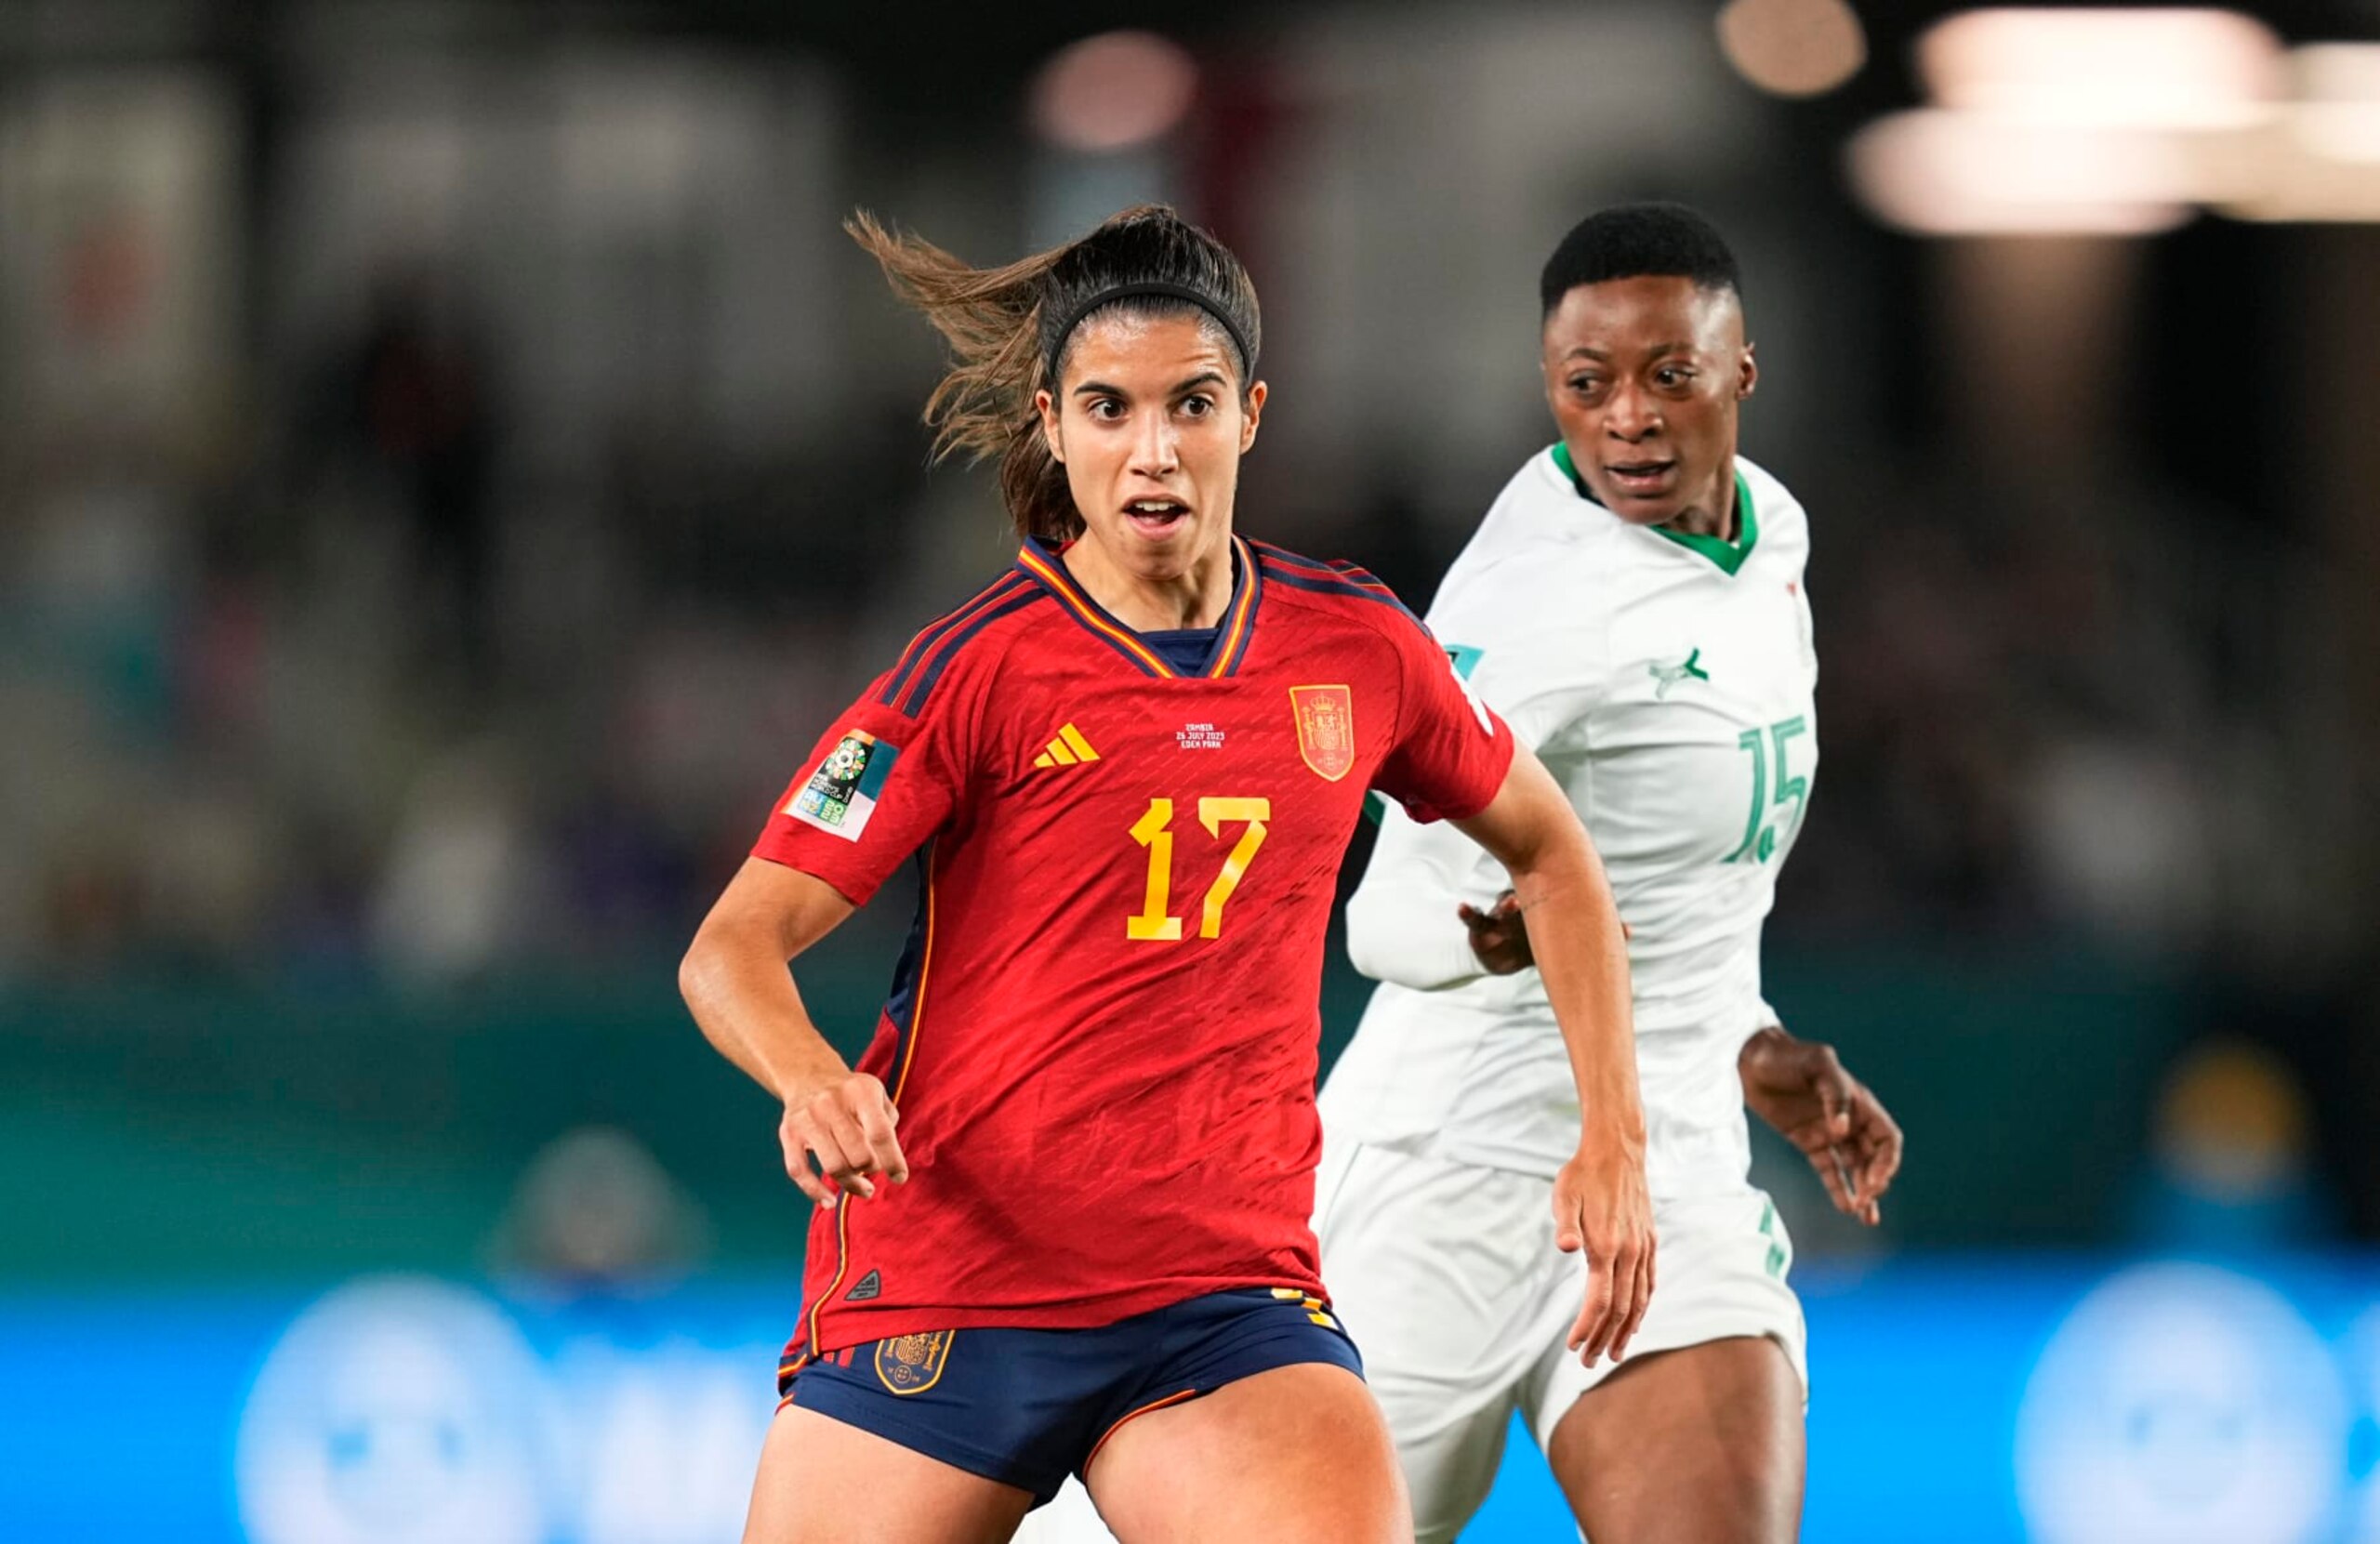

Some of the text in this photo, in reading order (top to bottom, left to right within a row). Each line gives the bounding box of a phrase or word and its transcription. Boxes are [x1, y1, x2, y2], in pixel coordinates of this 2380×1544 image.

[1185, 723, 1213, 732] ZAMBIA
[1176, 732, 1225, 741] 26 JULY 2023
[1181, 740, 1201, 749] EDEN
[1720, 714, 1806, 864] 15
[1127, 797, 1271, 941] 17
